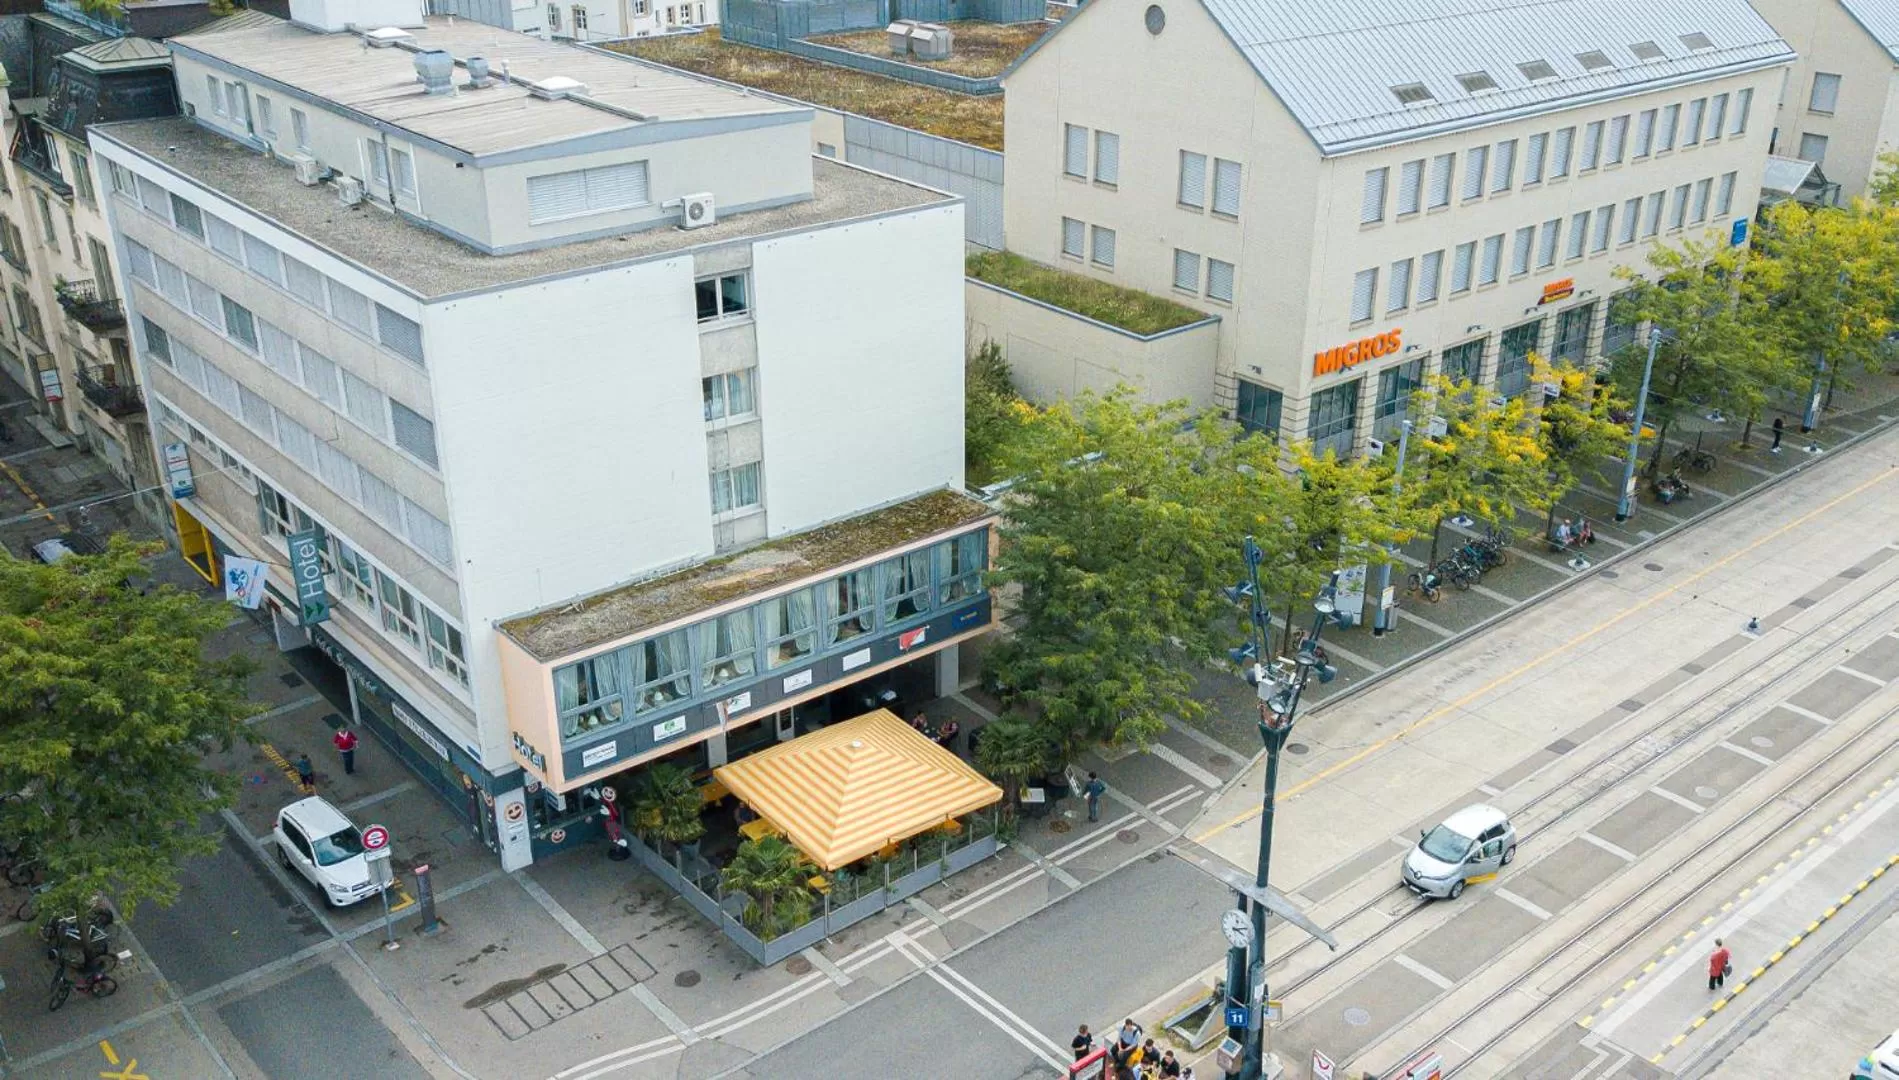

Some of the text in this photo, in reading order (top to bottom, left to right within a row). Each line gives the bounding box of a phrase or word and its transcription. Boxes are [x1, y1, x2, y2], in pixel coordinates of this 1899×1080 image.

[1314, 328, 1402, 377] MIGROS
[294, 537, 323, 599] Hotel
[1231, 1013, 1243, 1023] 11
